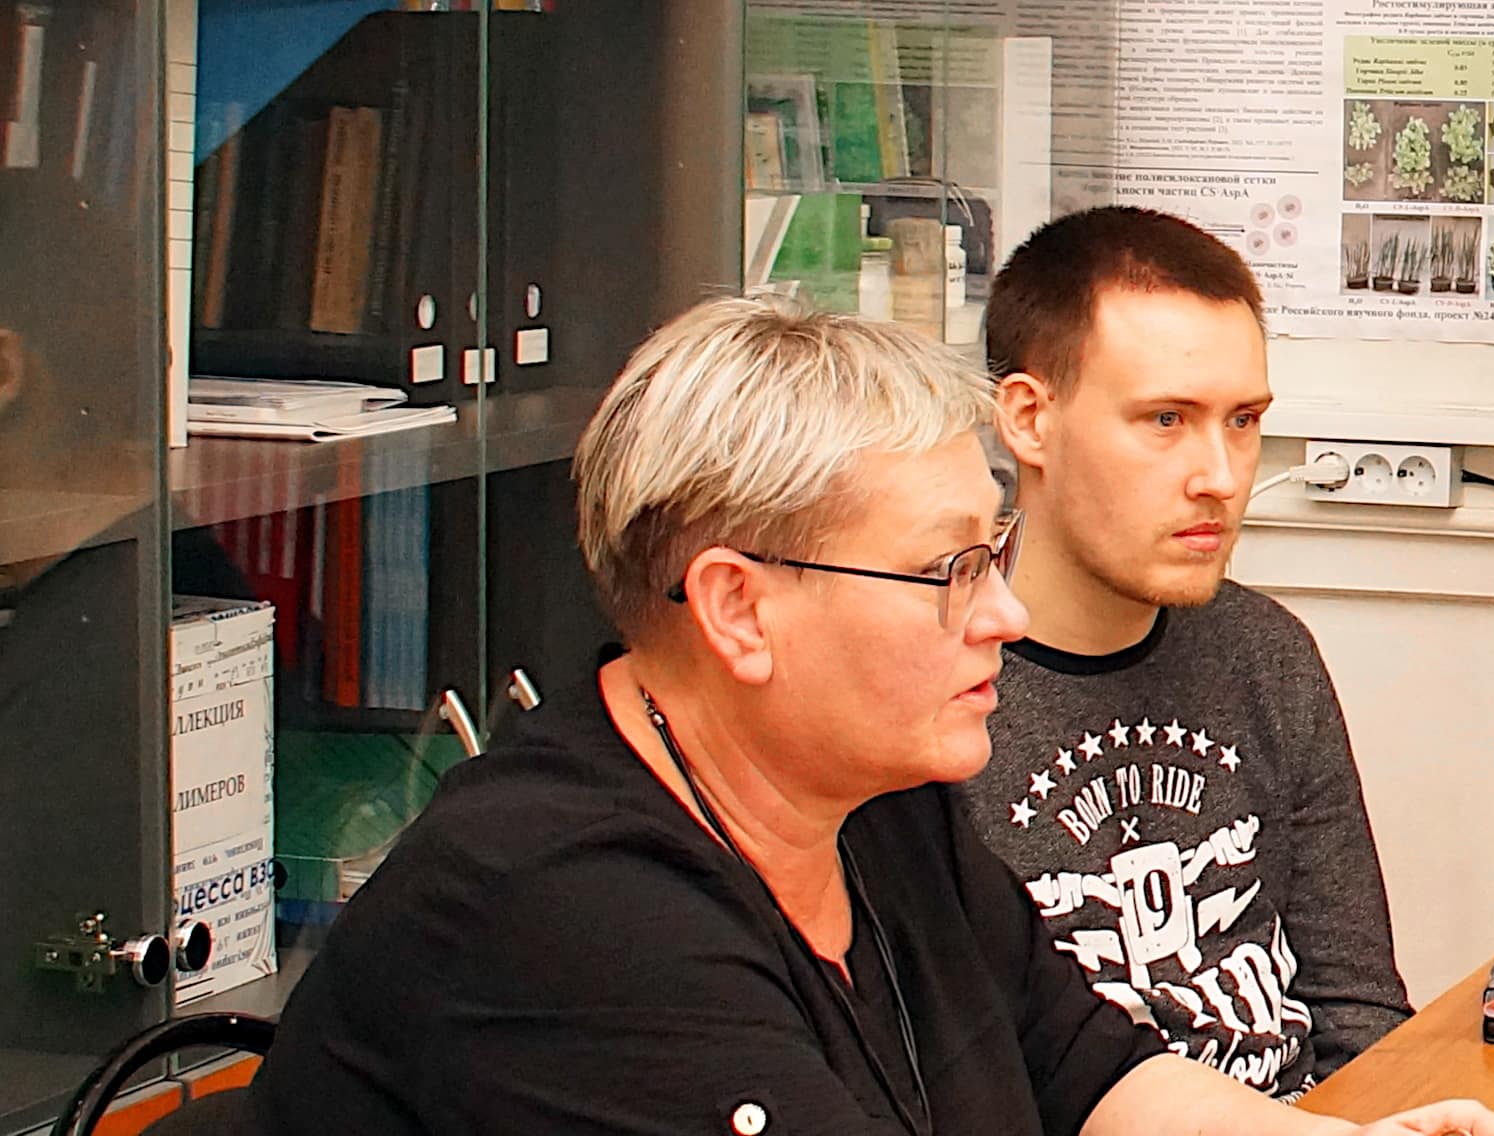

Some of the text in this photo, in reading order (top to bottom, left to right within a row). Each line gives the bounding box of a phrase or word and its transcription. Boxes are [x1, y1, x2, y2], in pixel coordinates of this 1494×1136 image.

[1281, 305, 1344, 317] Российского
[1347, 308, 1393, 319] научного
[1434, 311, 1469, 322] проект
[174, 699, 245, 736] ЛЛЕКЦИЯ
[173, 773, 246, 813] ЛИМЕРОВ
[1056, 763, 1206, 846] BORN TO RIDE
[174, 872, 244, 916] цесса
